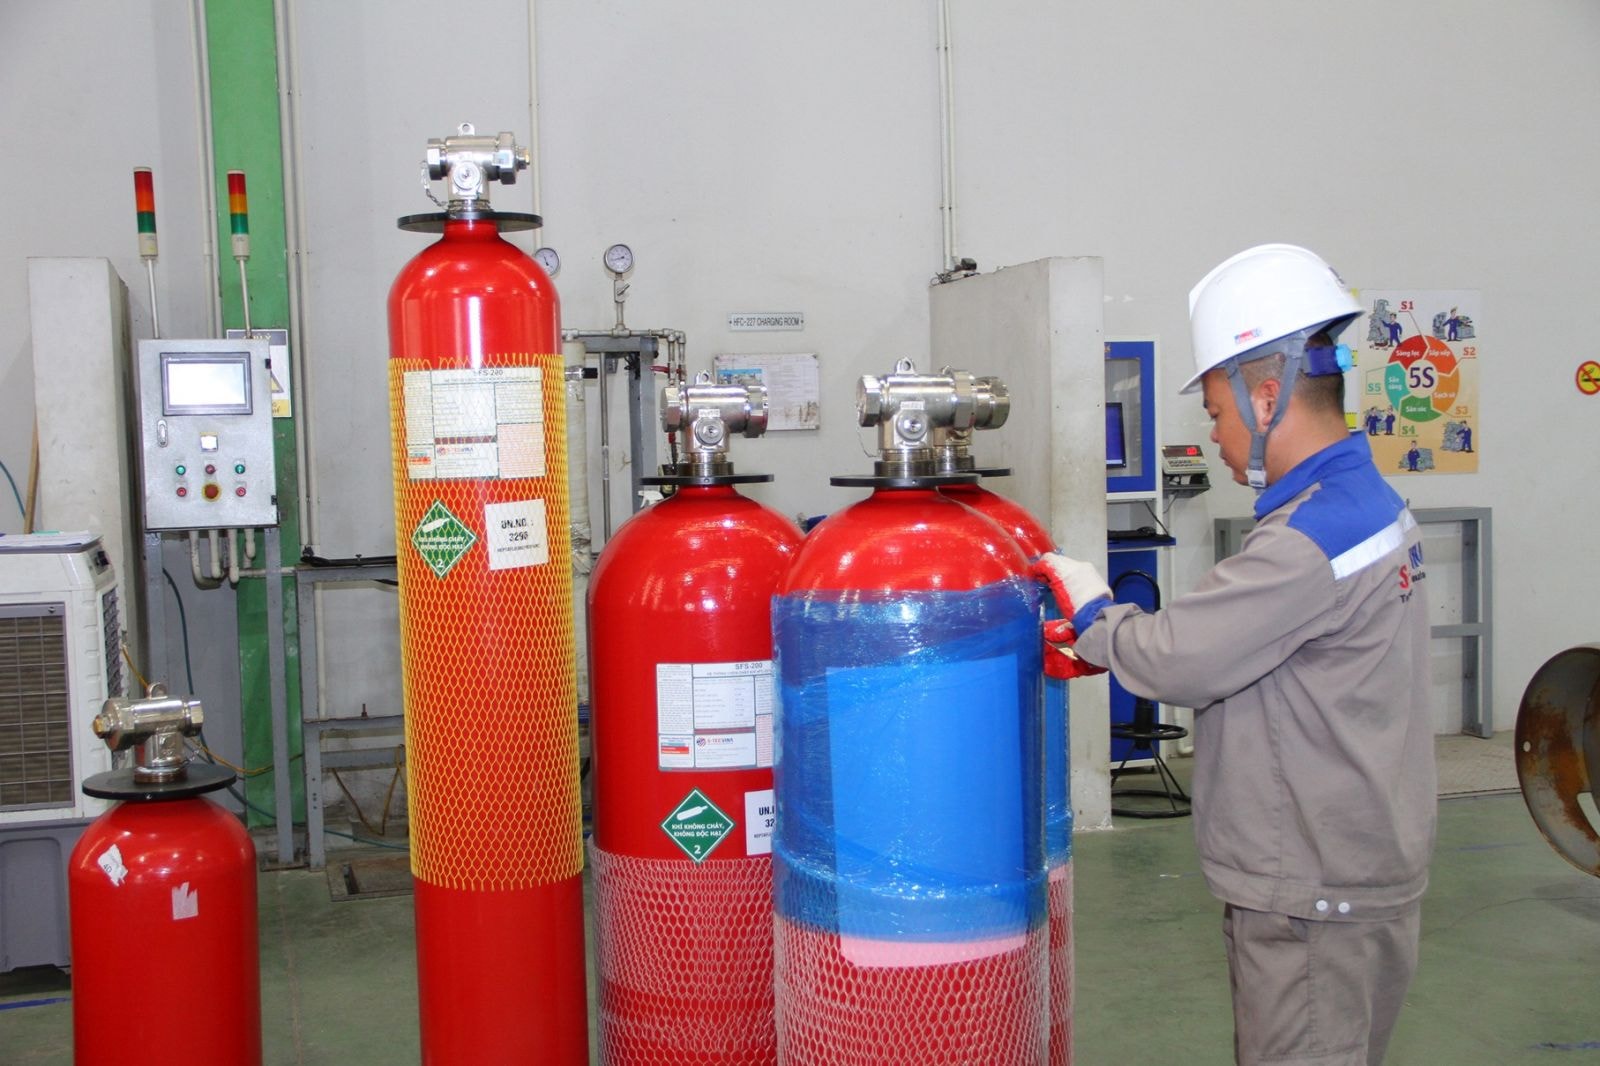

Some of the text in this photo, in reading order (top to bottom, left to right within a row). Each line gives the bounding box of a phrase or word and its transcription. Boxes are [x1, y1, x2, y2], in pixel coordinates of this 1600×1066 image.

[1401, 301, 1414, 310] S1
[733, 316, 800, 327] HFC-227 CHARGING ROOM
[1463, 347, 1476, 356] S2
[1409, 366, 1434, 388] 5S
[1368, 383, 1381, 392] S5
[1402, 425, 1416, 435] S4
[684, 822, 705, 830] KHÔNG
[694, 844, 701, 854] 2
